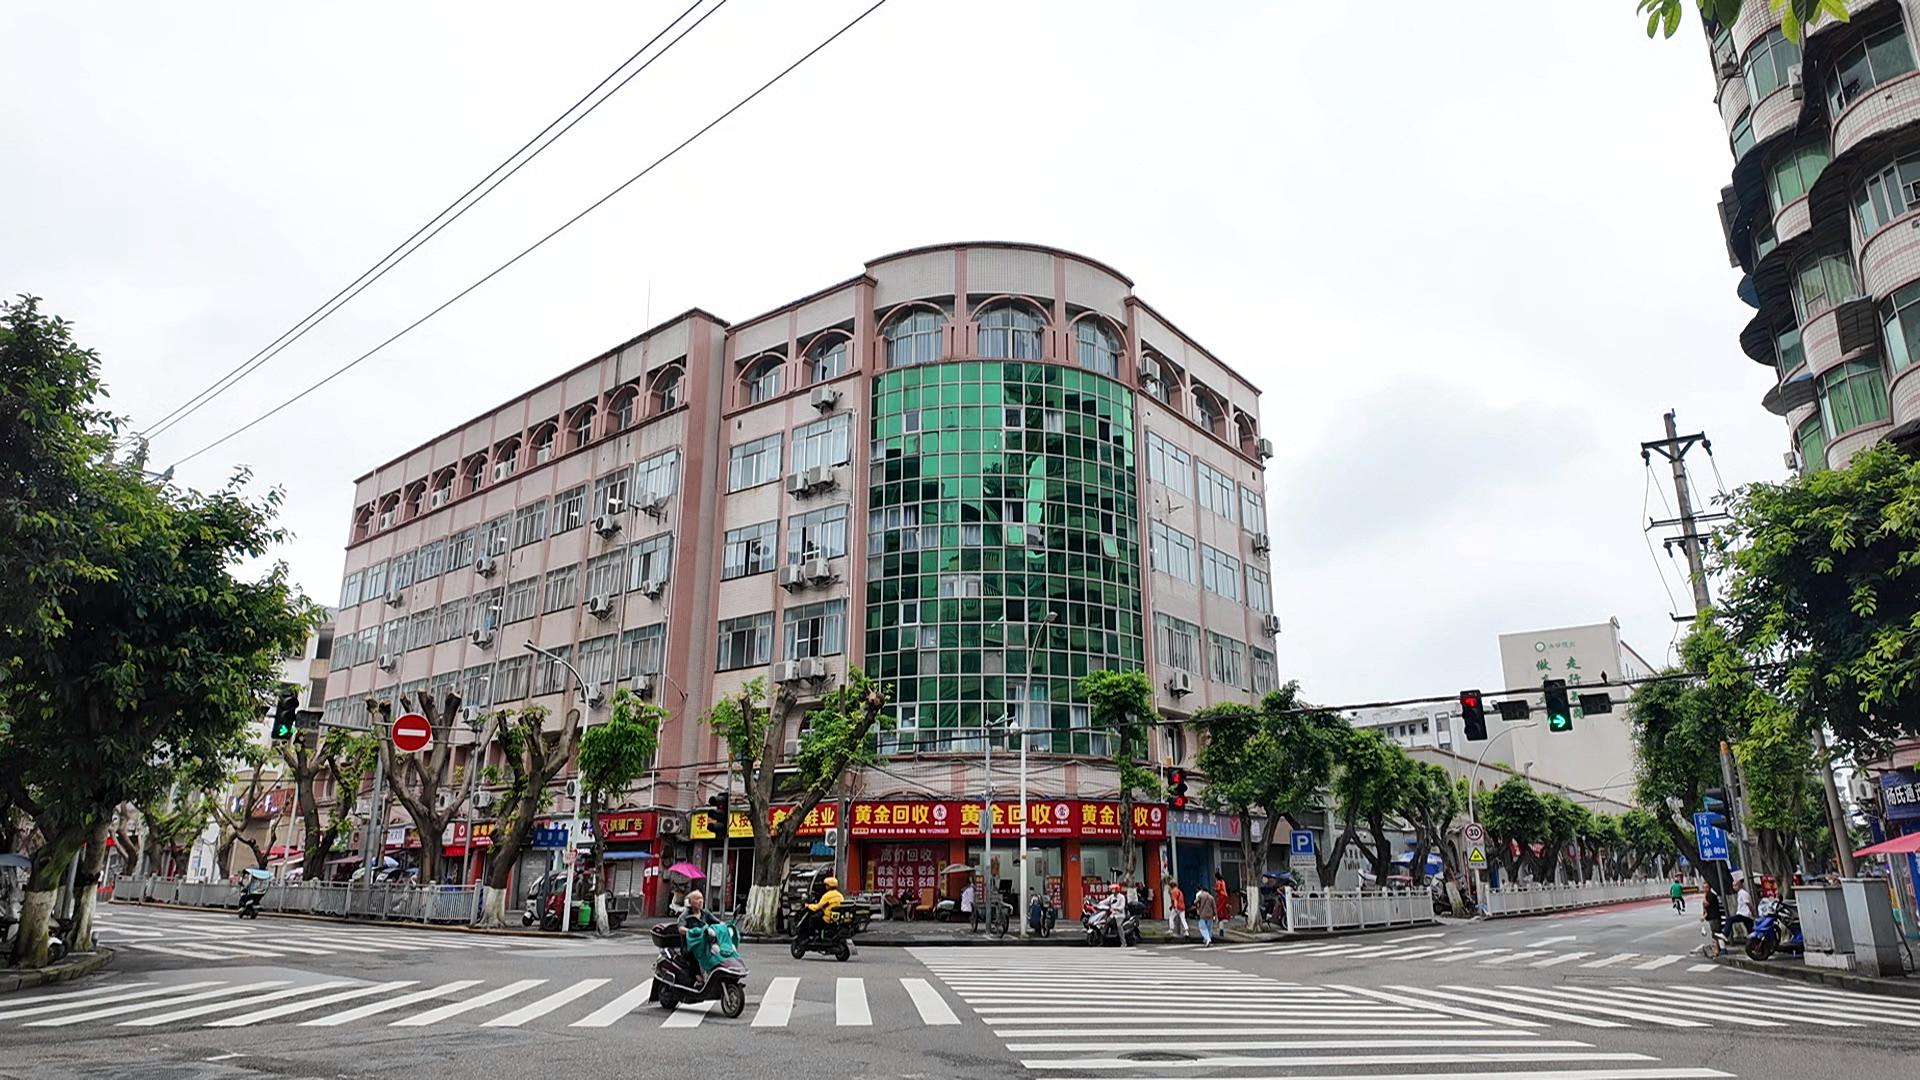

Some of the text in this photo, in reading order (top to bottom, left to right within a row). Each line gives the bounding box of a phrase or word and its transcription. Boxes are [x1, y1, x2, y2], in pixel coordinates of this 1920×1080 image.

[855, 803, 930, 825] 黄金回收
[960, 803, 1052, 826] 黄金回收
[1081, 803, 1149, 827] 黄金收
[1468, 828, 1479, 837] 30
[1698, 815, 1714, 859] 行知小学
[1297, 835, 1310, 851] P
[880, 847, 933, 863] 高价回收
[878, 865, 894, 876] 黄金
[898, 865, 913, 876] K金
